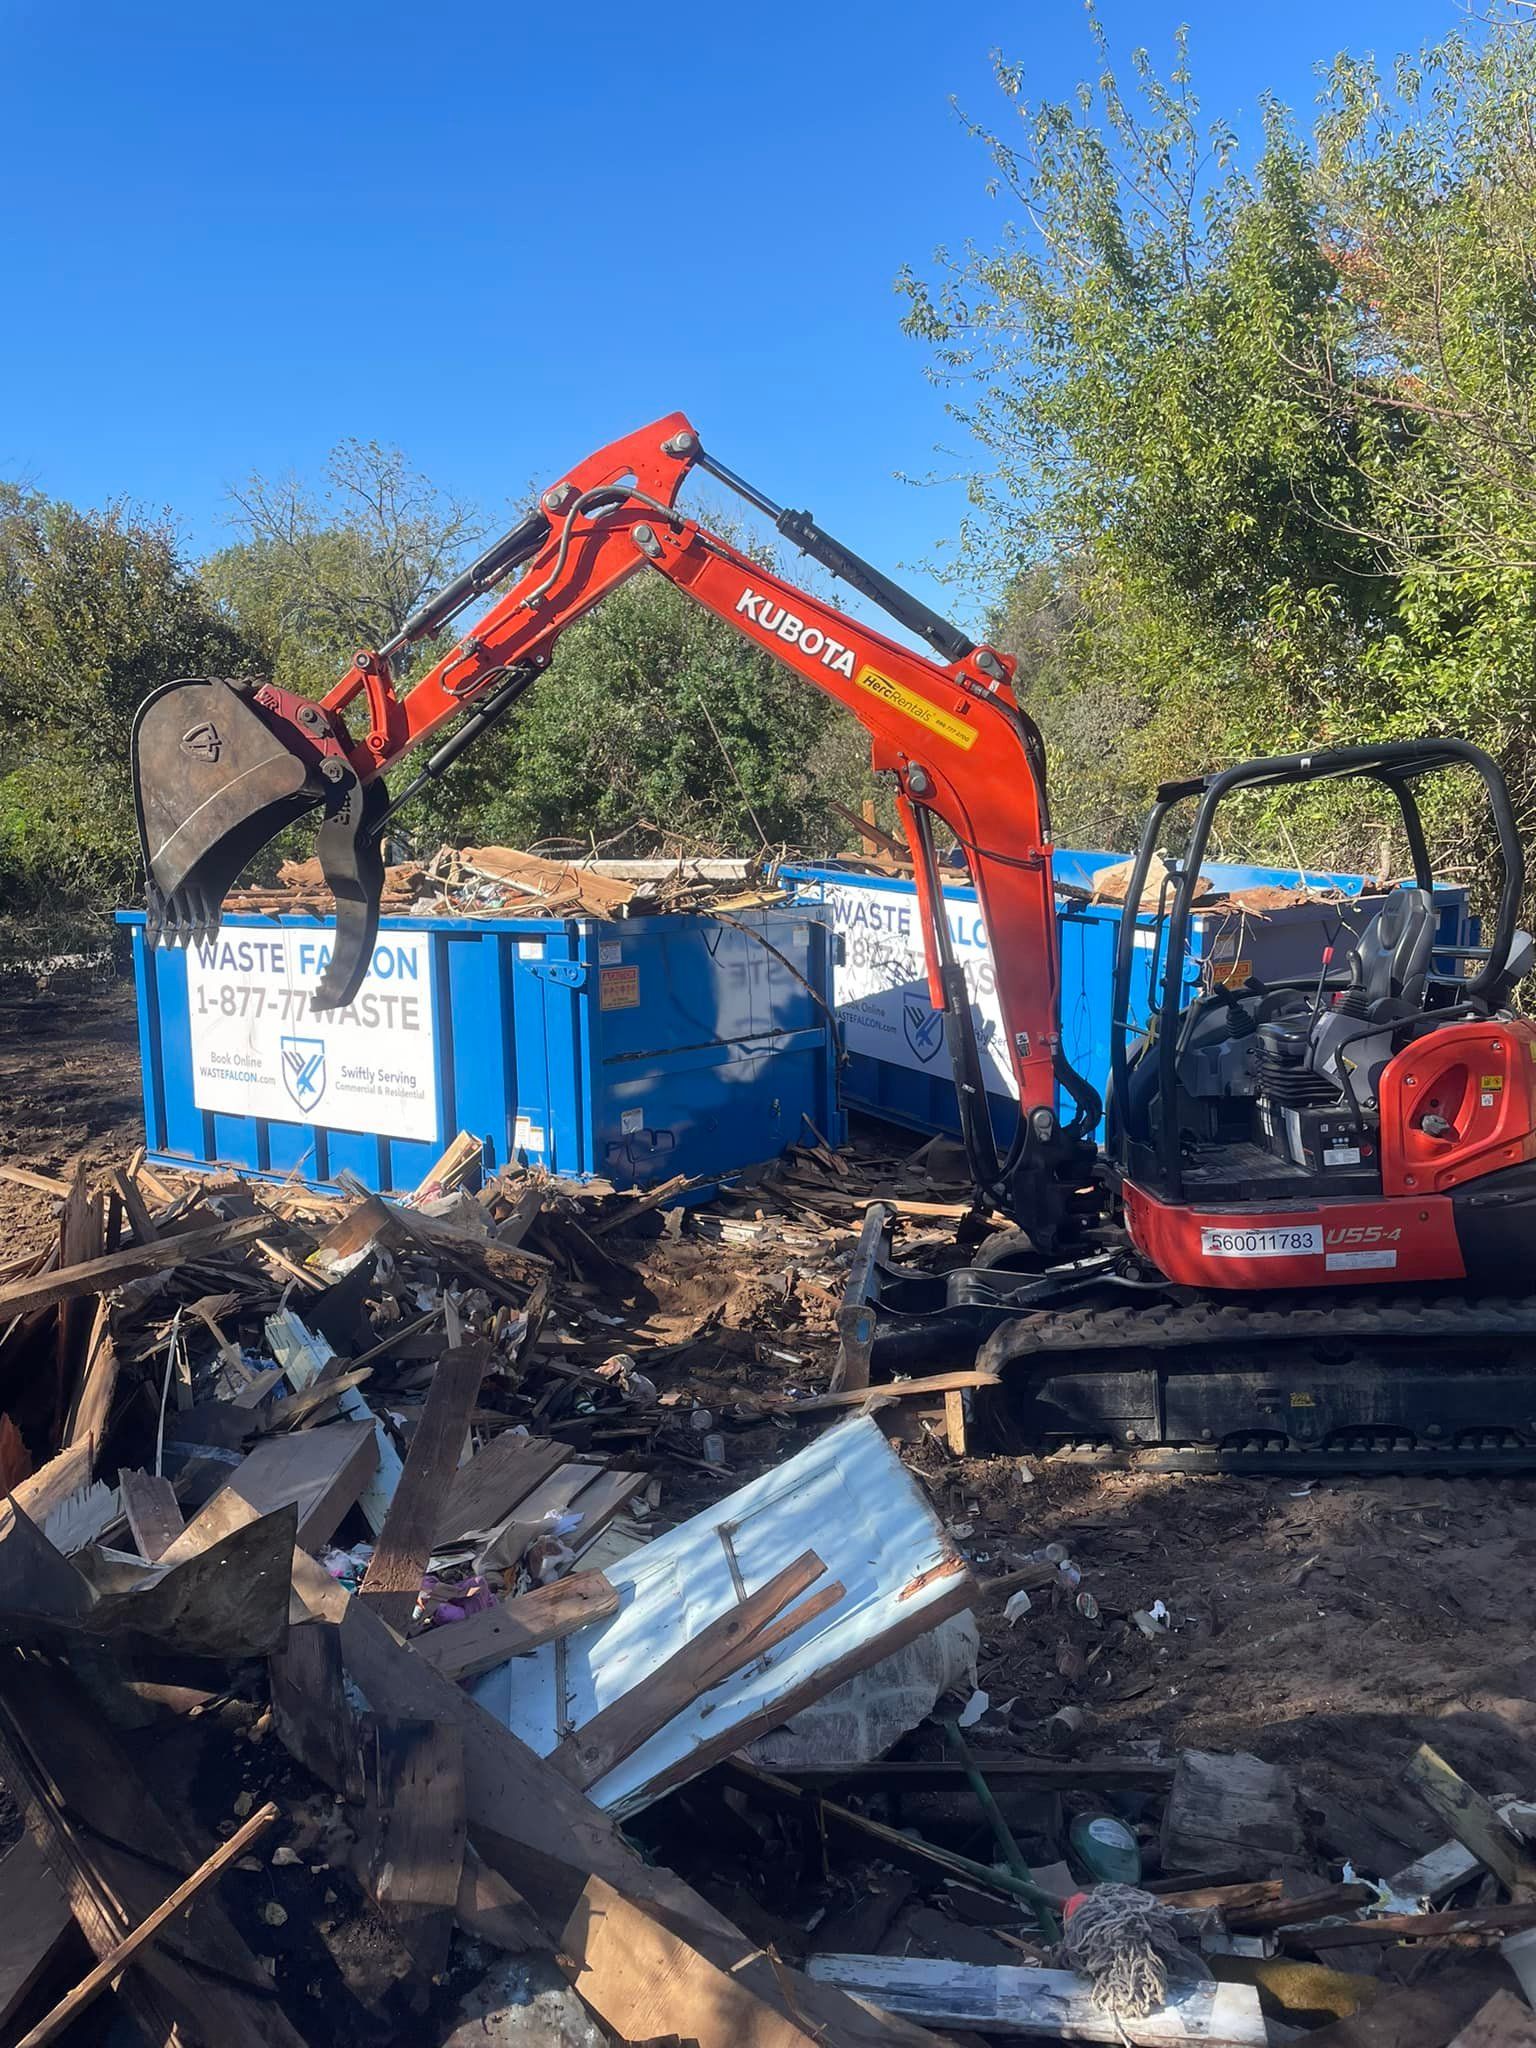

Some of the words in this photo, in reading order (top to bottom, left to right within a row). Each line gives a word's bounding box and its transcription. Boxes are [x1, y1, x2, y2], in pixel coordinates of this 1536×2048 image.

[735, 587, 856, 680] KUBOTA
[863, 675, 933, 722] HercRentals
[832, 897, 911, 934] WASTE
[200, 940, 285, 973] WASTE
[300, 944, 418, 980] FAON
[211, 1051, 231, 1065] Book
[233, 1053, 263, 1068] Online
[200, 1066, 277, 1085] WASTEFALCON.com
[341, 1065, 375, 1085] Swiftly
[378, 1069, 417, 1088] Serving
[335, 1081, 376, 1095] Commercial
[384, 1086, 425, 1099] Residential
[1211, 1232, 1314, 1251] 560011783
[1326, 1227, 1402, 1245] U55-4
